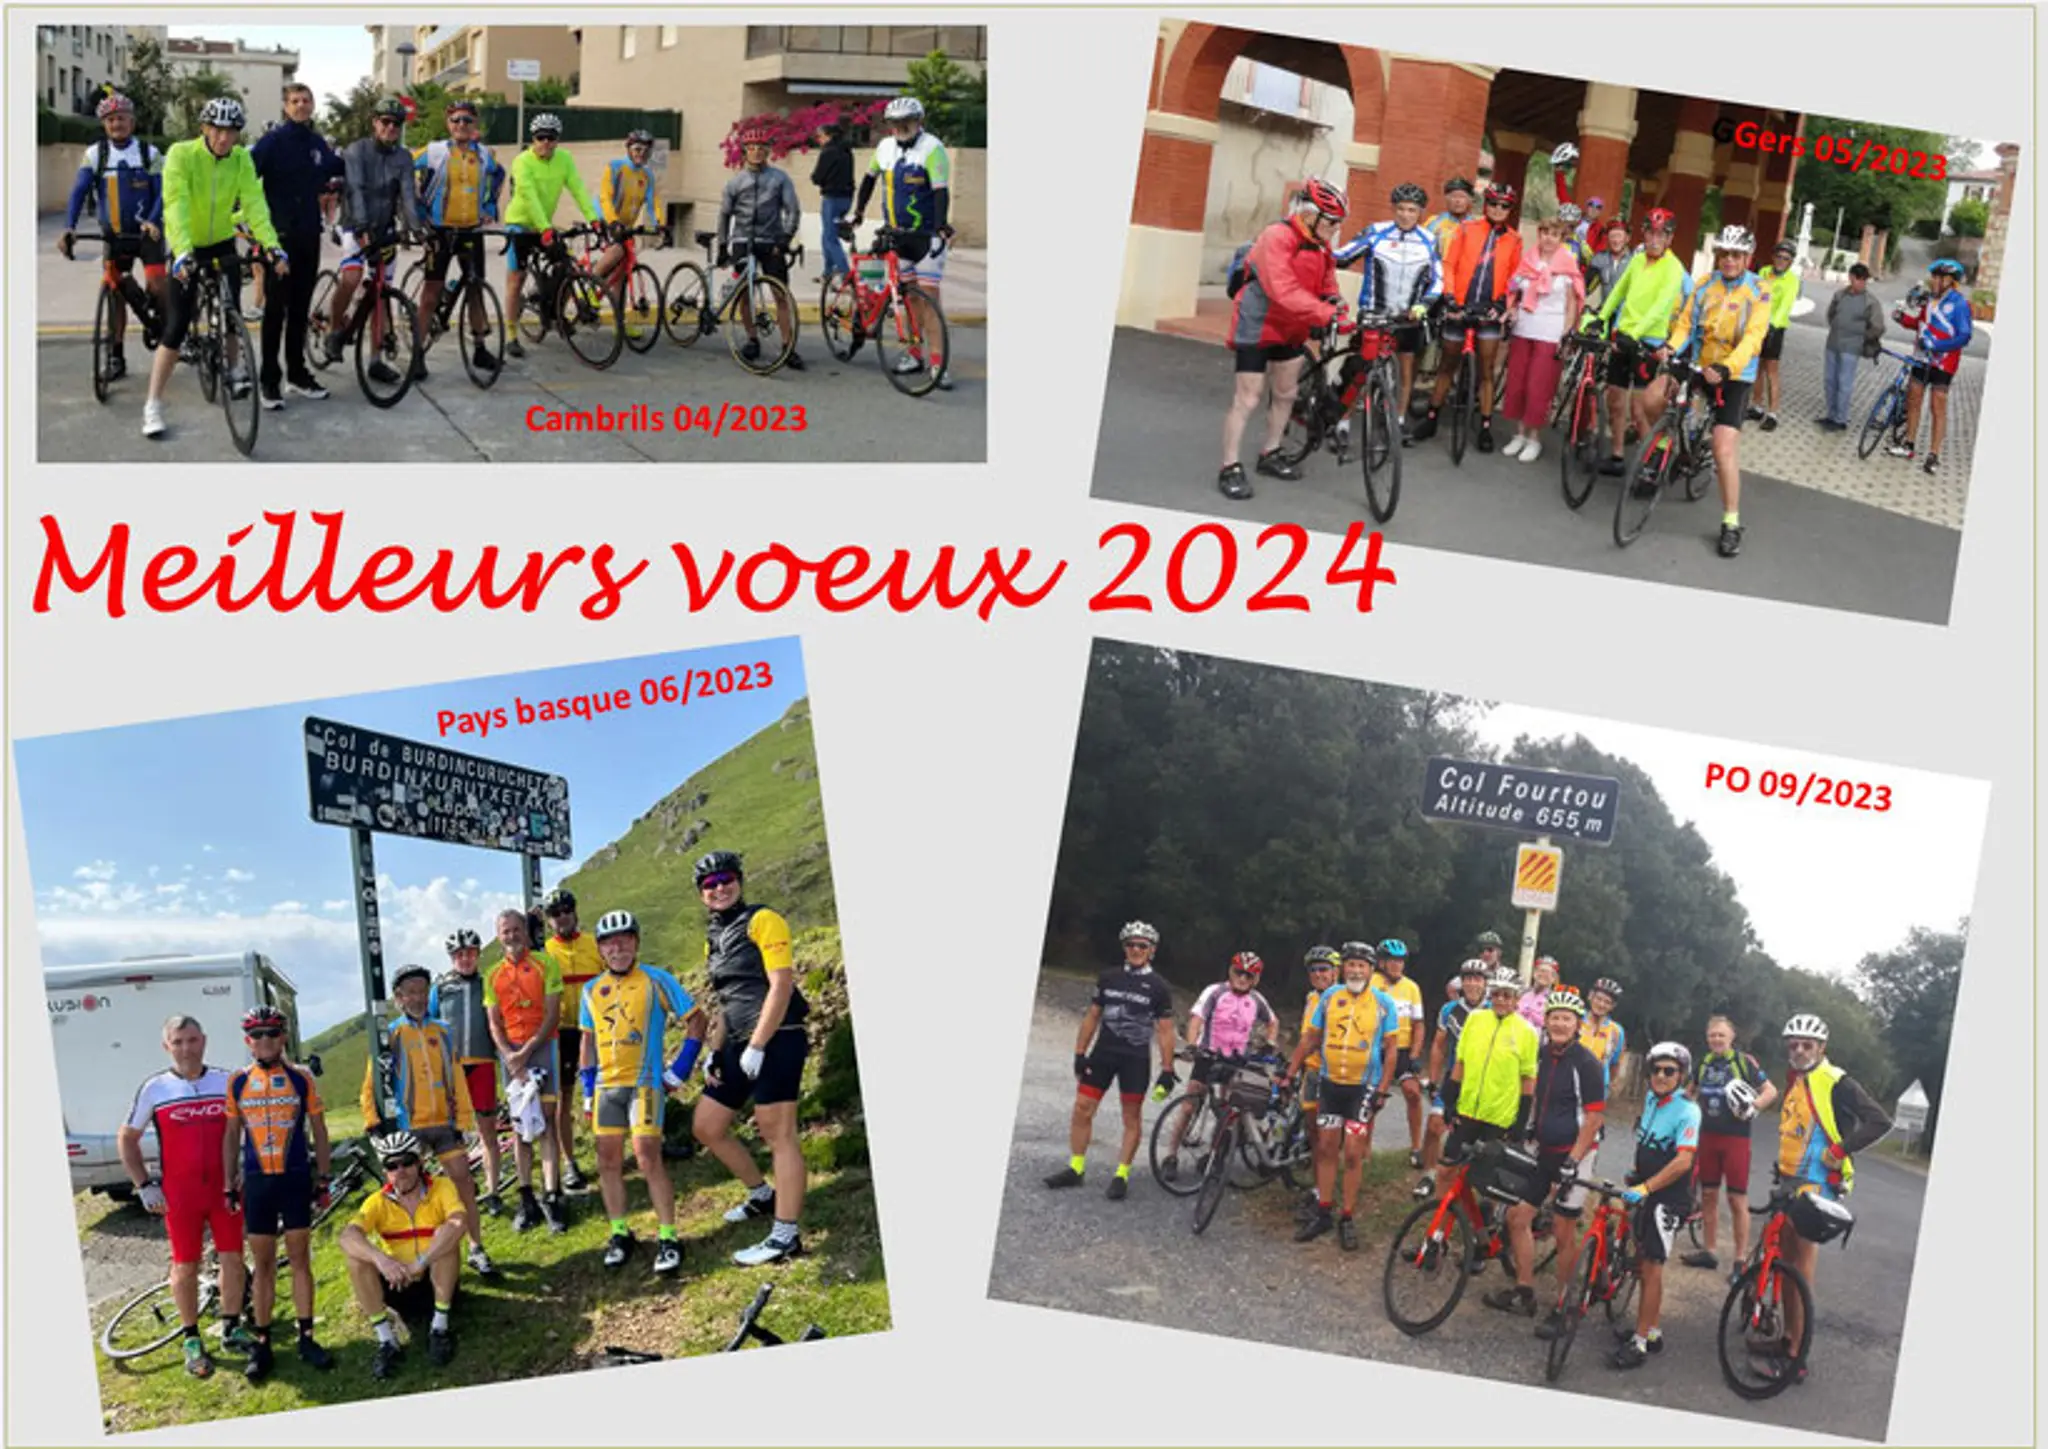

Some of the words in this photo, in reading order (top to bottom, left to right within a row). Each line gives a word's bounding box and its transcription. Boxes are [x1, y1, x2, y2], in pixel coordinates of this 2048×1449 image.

[324, 726, 357, 752] Col
[368, 738, 390, 758] de
[1438, 766, 1487, 793] Col
[1497, 774, 1608, 809] Fourtou
[1433, 793, 1525, 823] Altitude
[1535, 806, 1581, 829] 655
[1584, 817, 1603, 832] m
